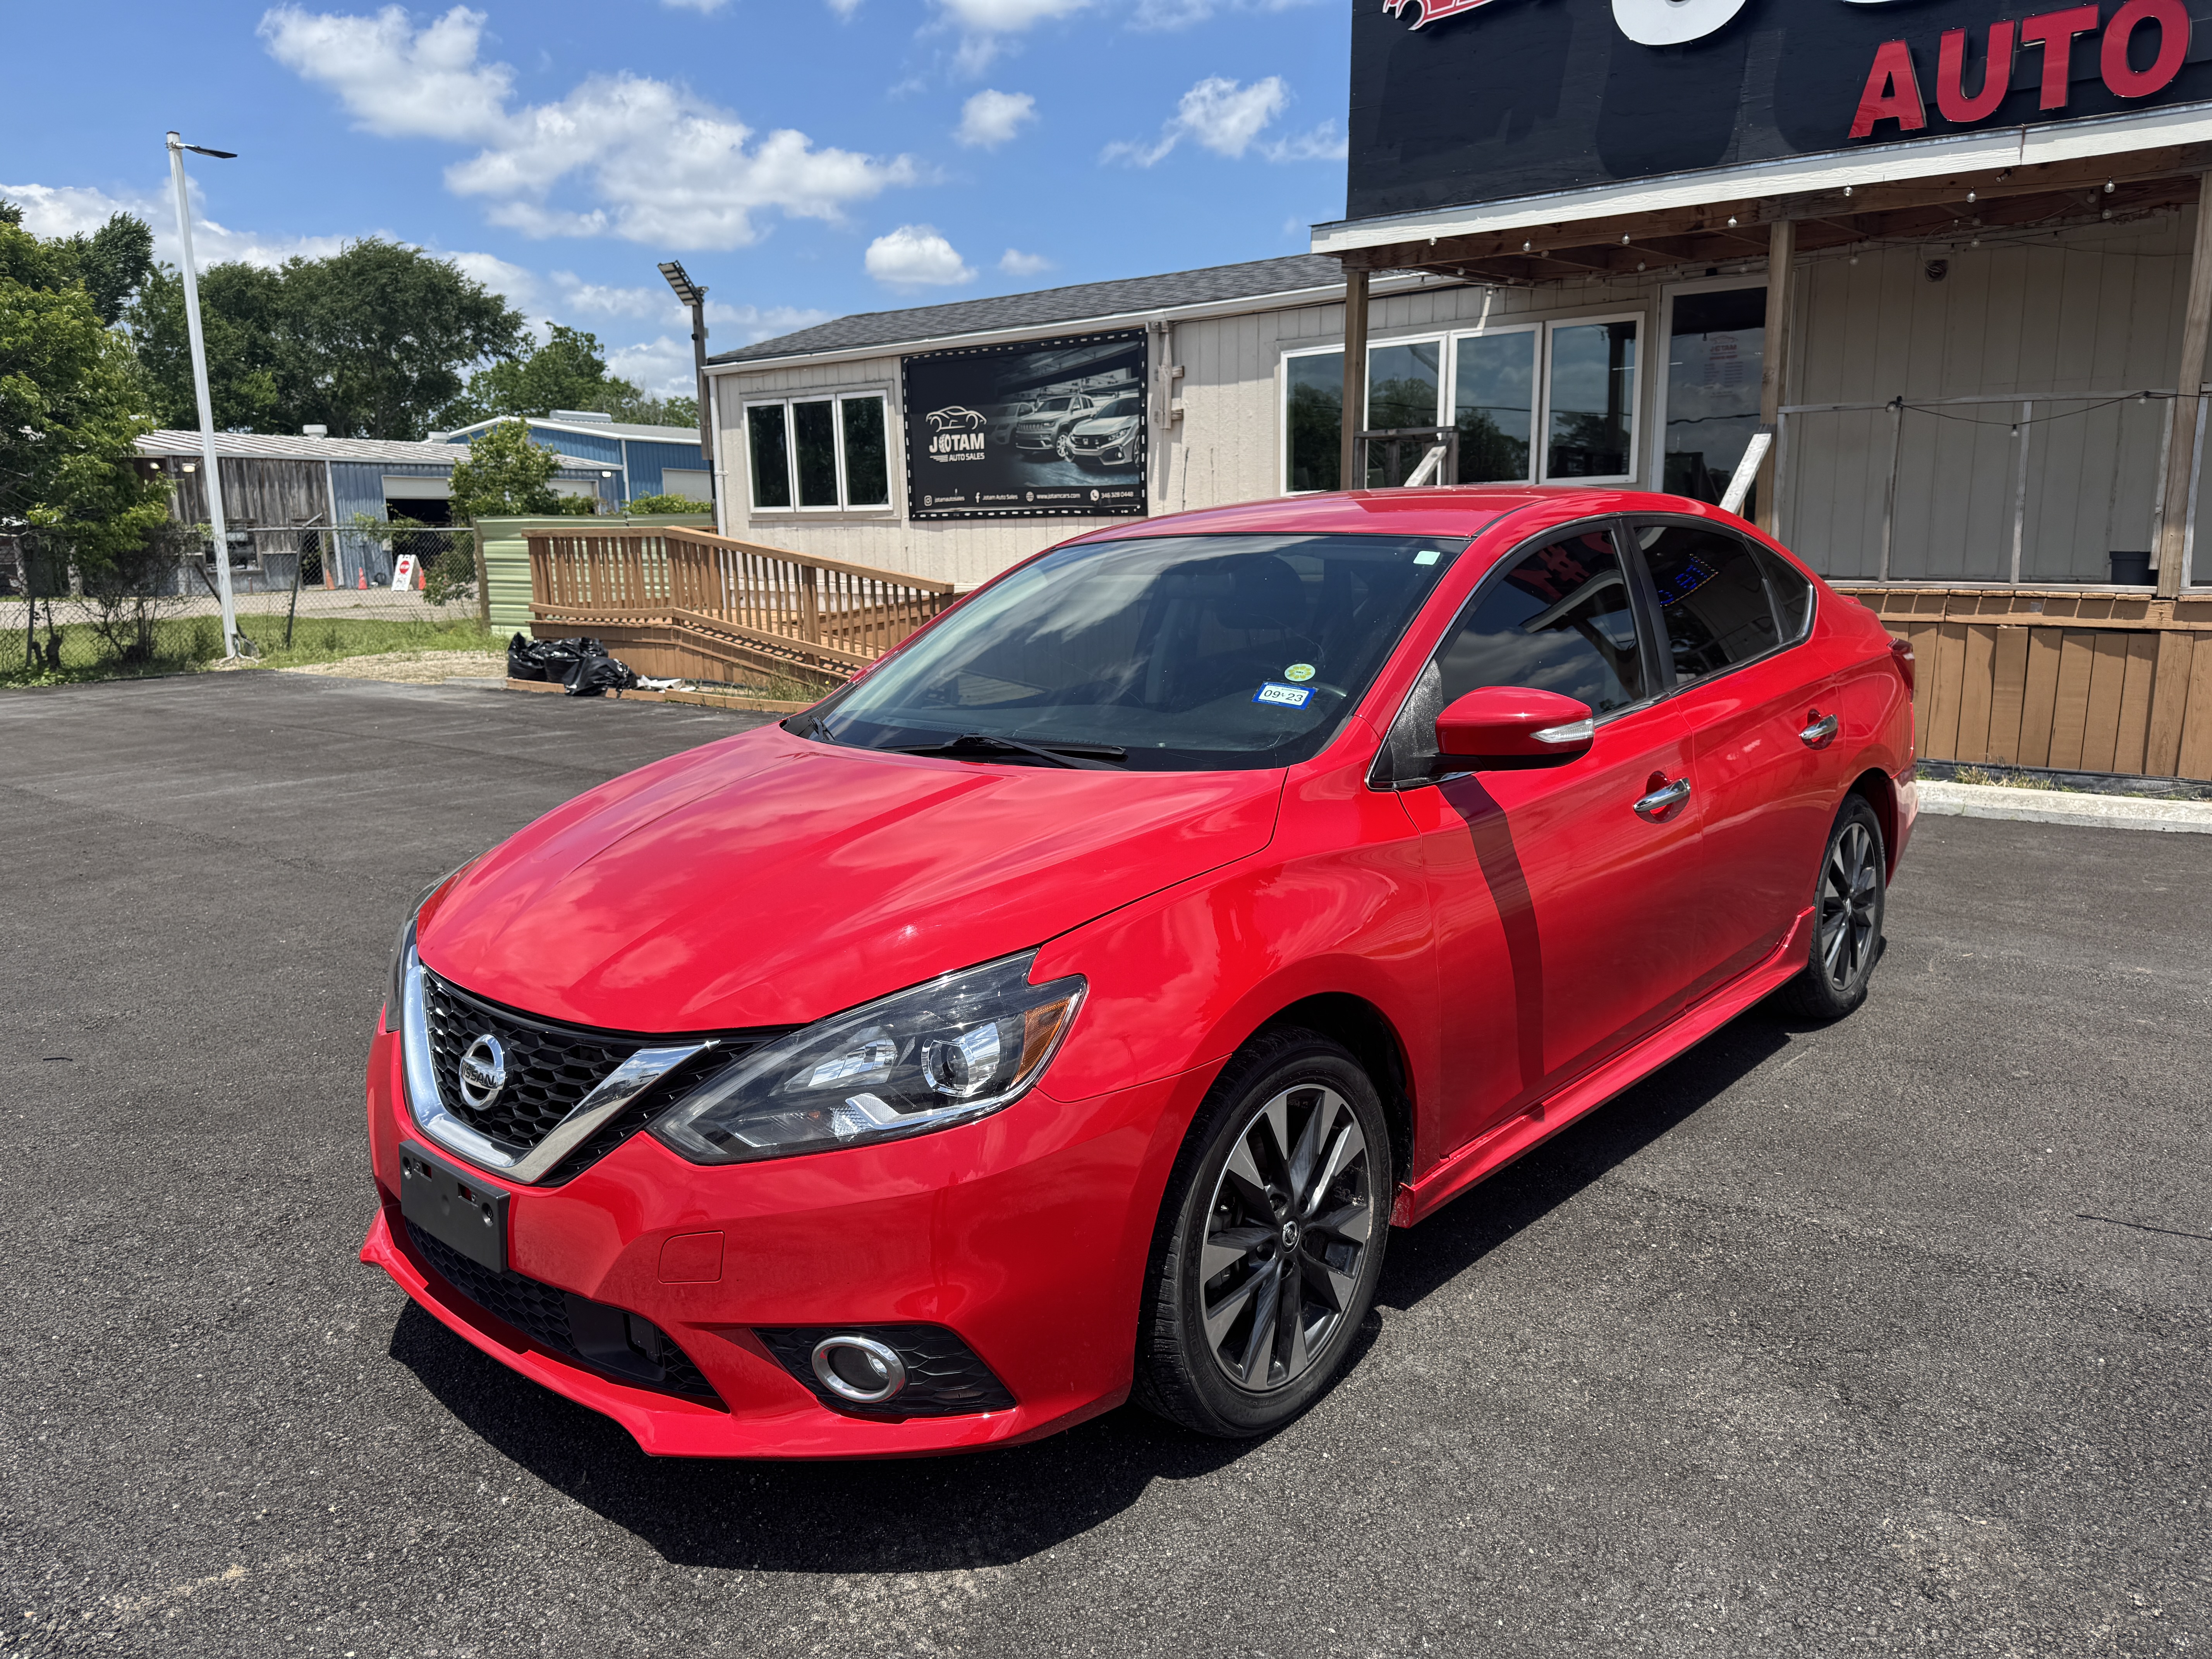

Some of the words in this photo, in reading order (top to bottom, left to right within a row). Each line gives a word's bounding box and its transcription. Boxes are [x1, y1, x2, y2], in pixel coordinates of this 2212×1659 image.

[1848, 0, 2190, 139] AUTO
[929, 433, 985, 453] JOTAM
[949, 453, 965, 462] AUTO
[966, 452, 985, 460] SALES
[1264, 690, 1281, 698] 09
[1285, 693, 1304, 702] 23
